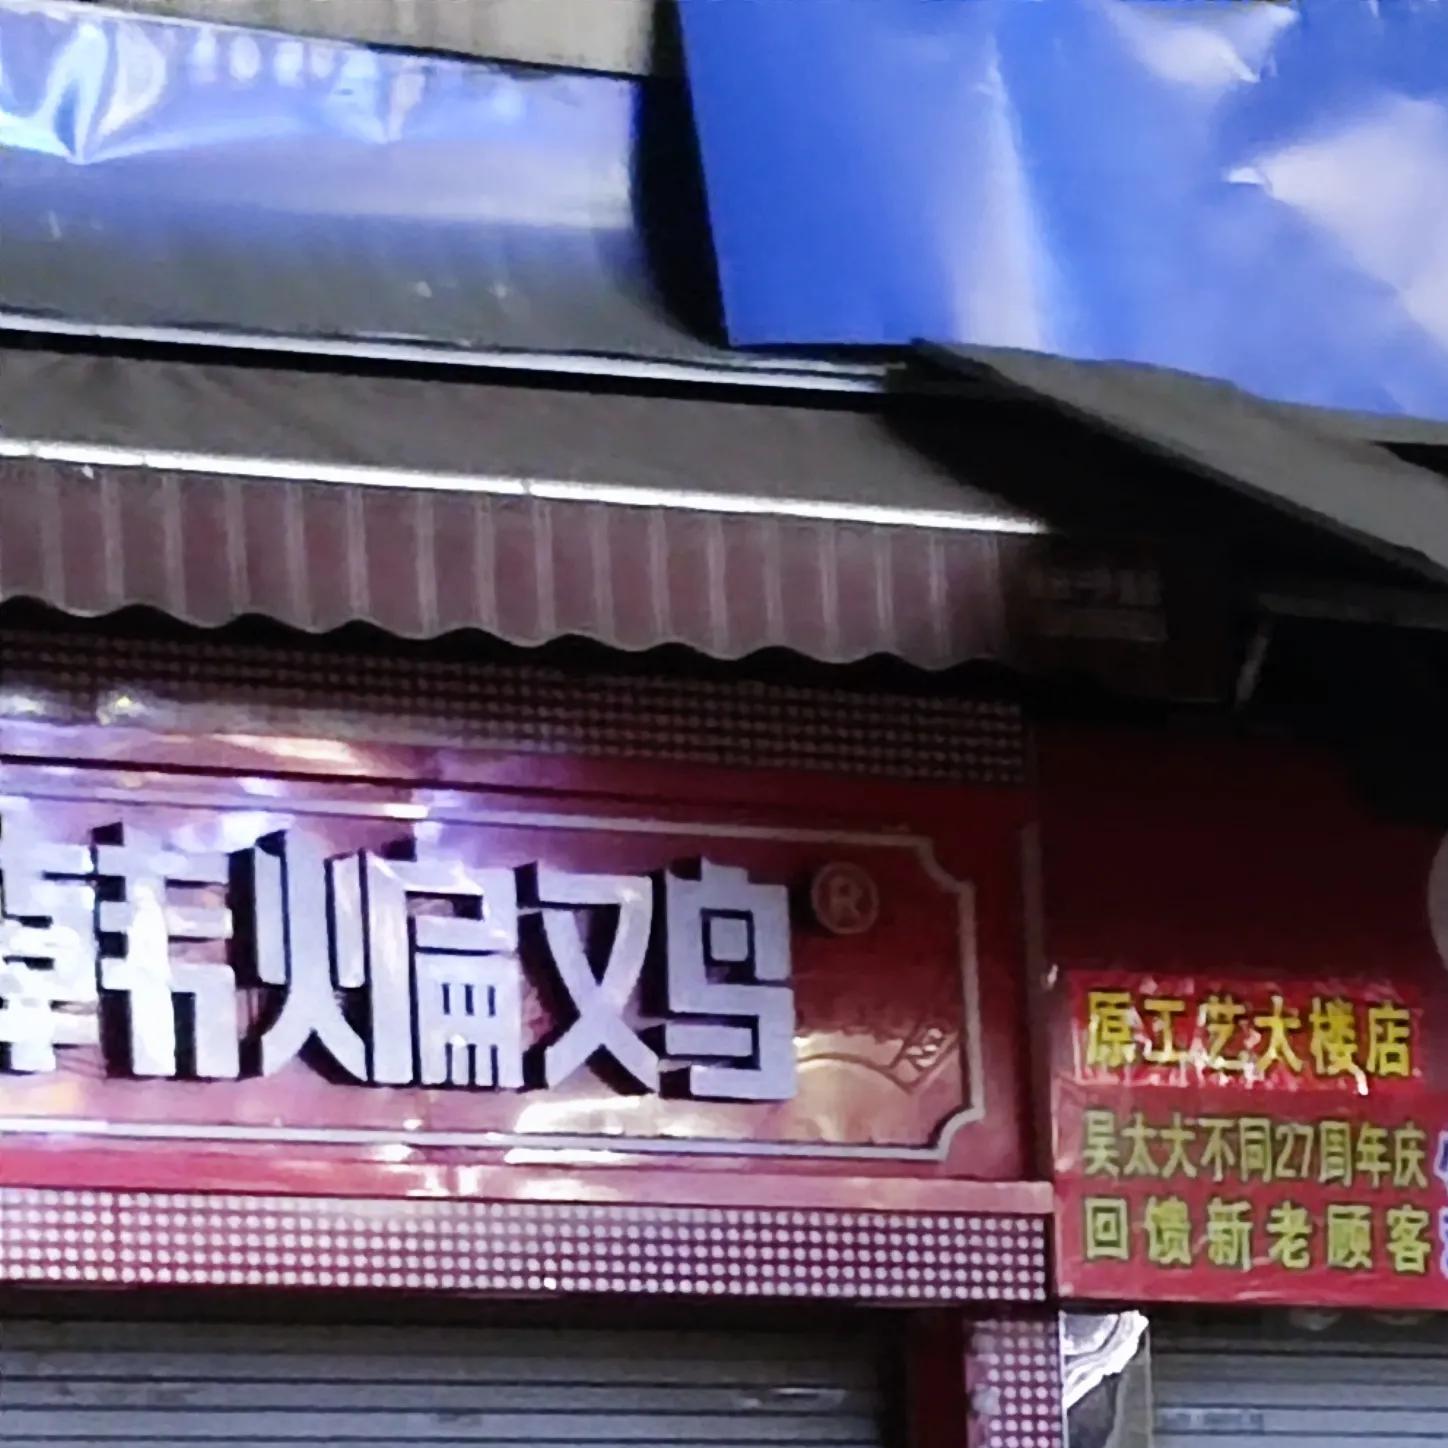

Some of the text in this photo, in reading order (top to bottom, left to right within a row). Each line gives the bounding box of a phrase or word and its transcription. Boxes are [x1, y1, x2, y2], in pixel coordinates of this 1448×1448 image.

[1086, 990, 1411, 1076] 原工艺大楼店
[1083, 1194, 1433, 1275] 回馈新老顾客
